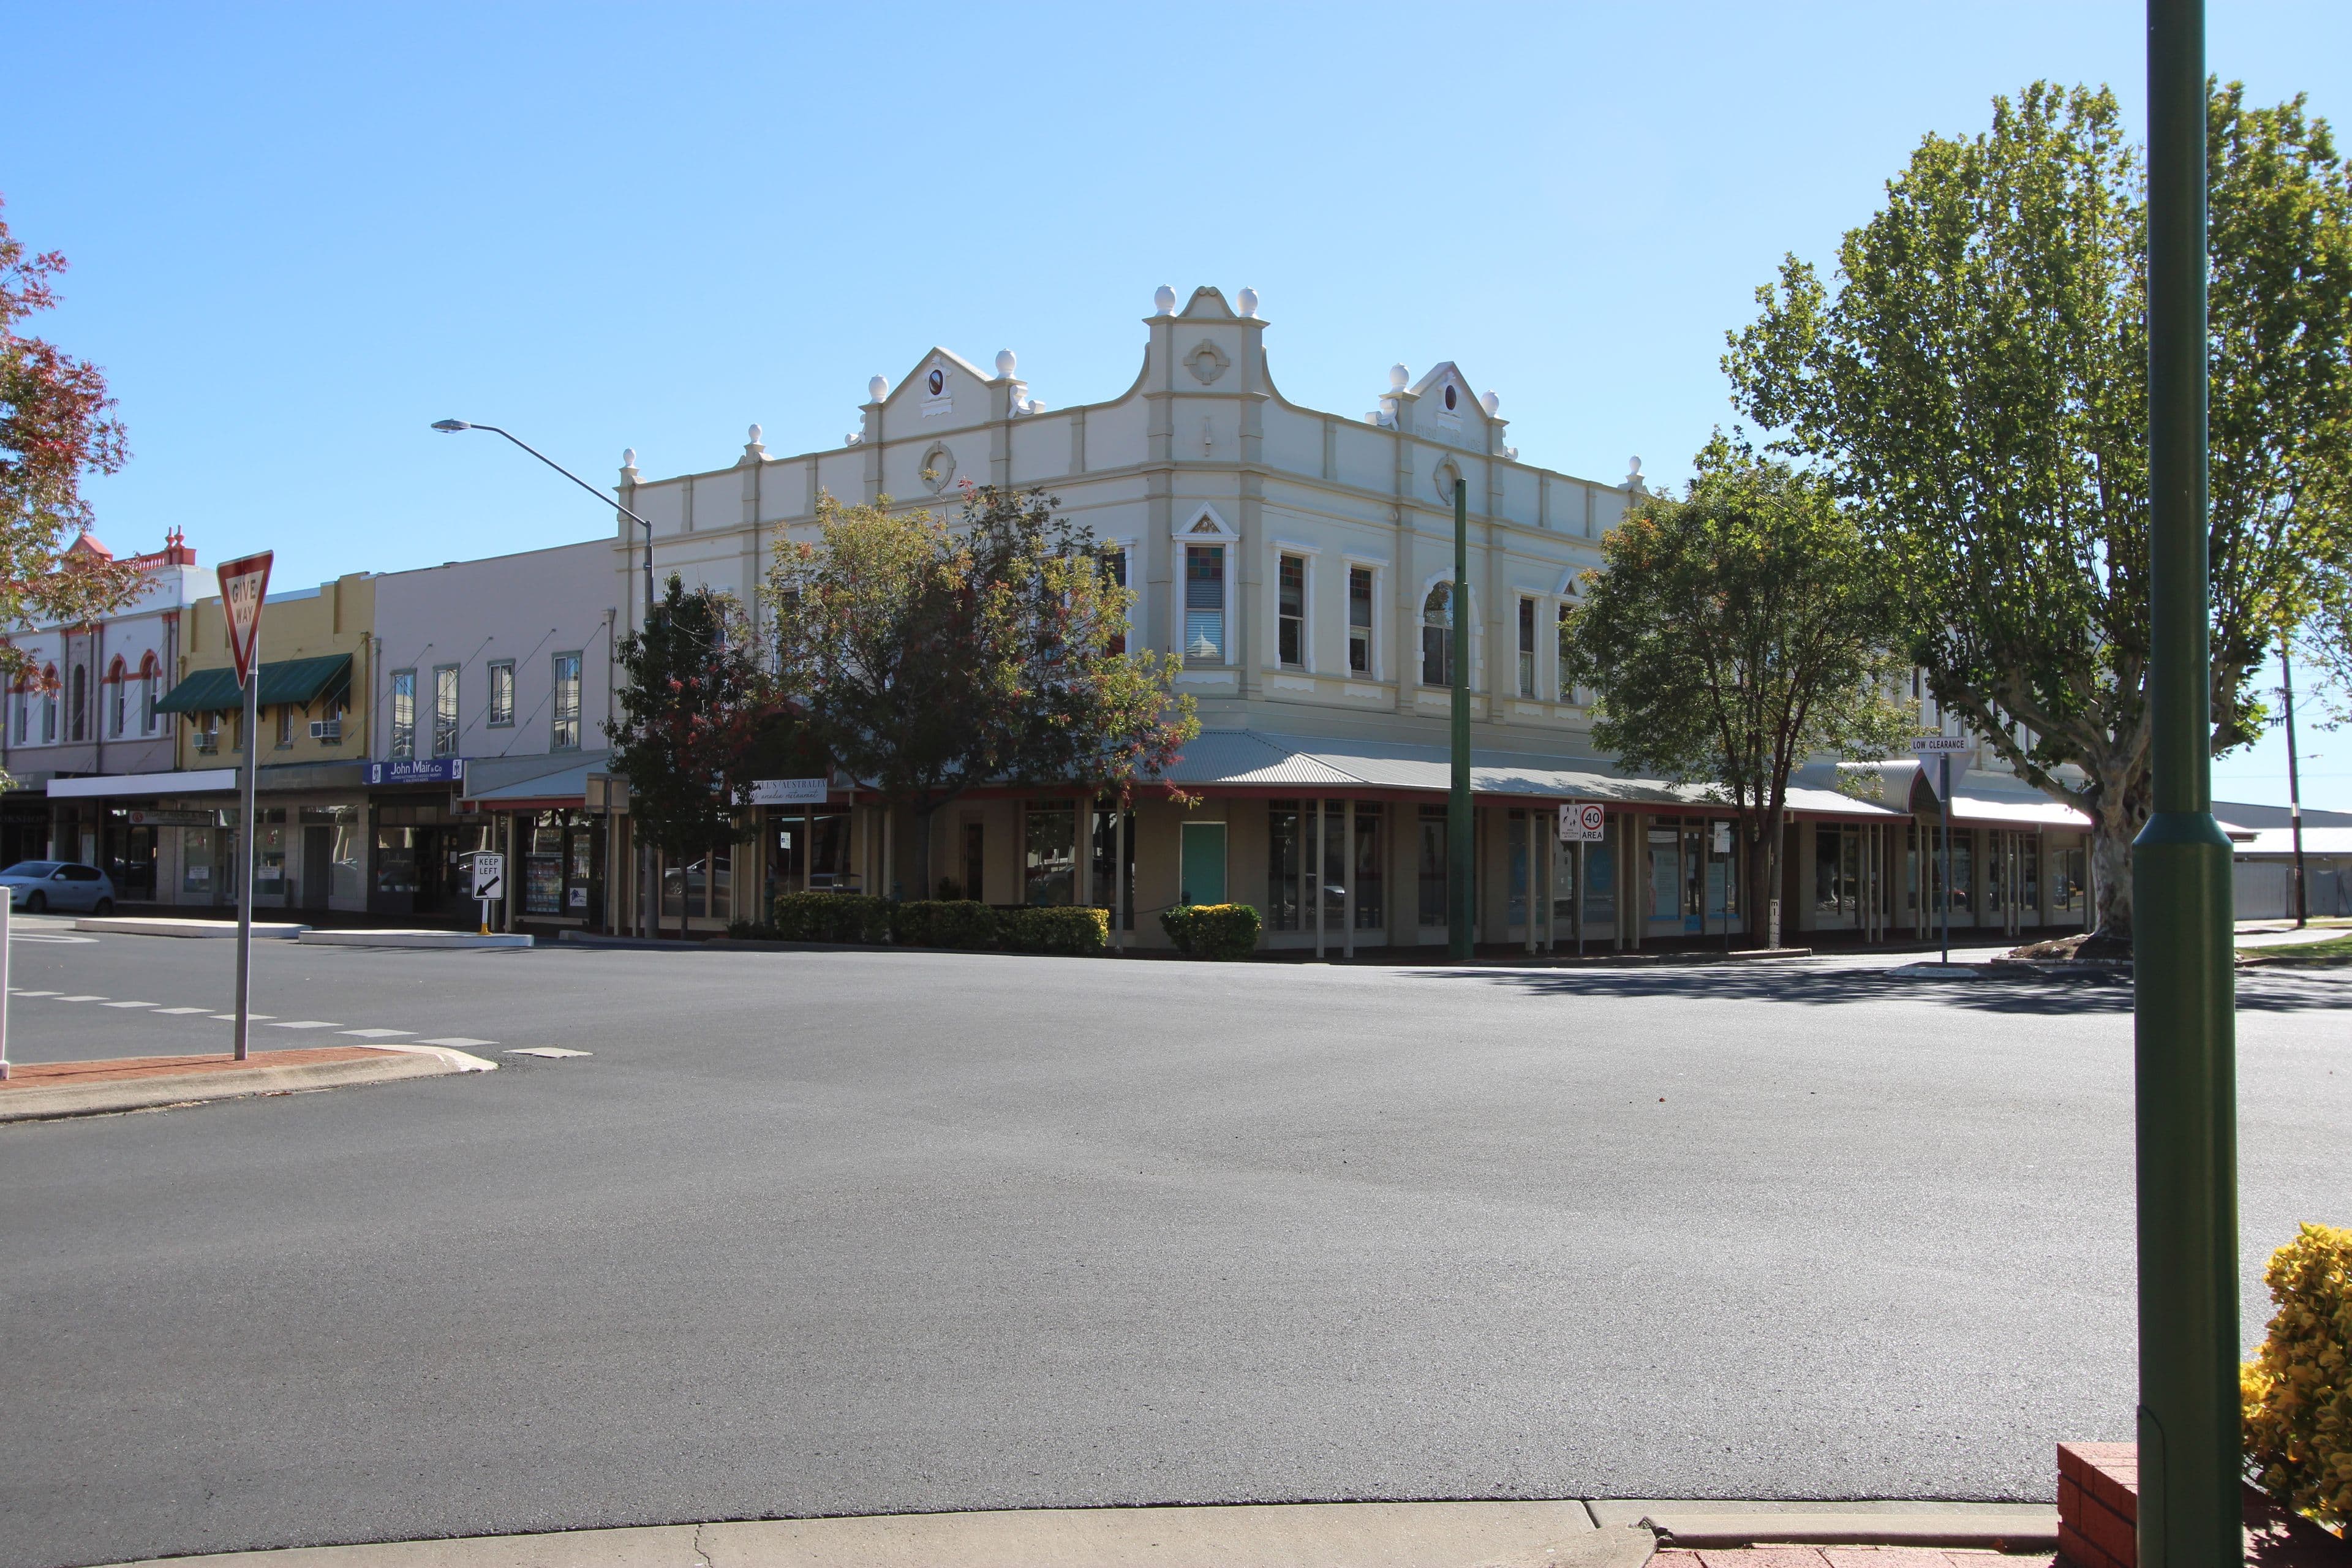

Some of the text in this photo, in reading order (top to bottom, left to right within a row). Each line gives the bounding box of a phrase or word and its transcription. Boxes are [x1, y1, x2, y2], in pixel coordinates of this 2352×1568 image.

[232, 579, 256, 603] GIVE
[236, 606, 253, 624] WAY
[1913, 740, 1964, 749] LOW CLEARANCE
[391, 762, 410, 775] John
[413, 761, 431, 774] Mair
[1585, 812, 1599, 823] 40
